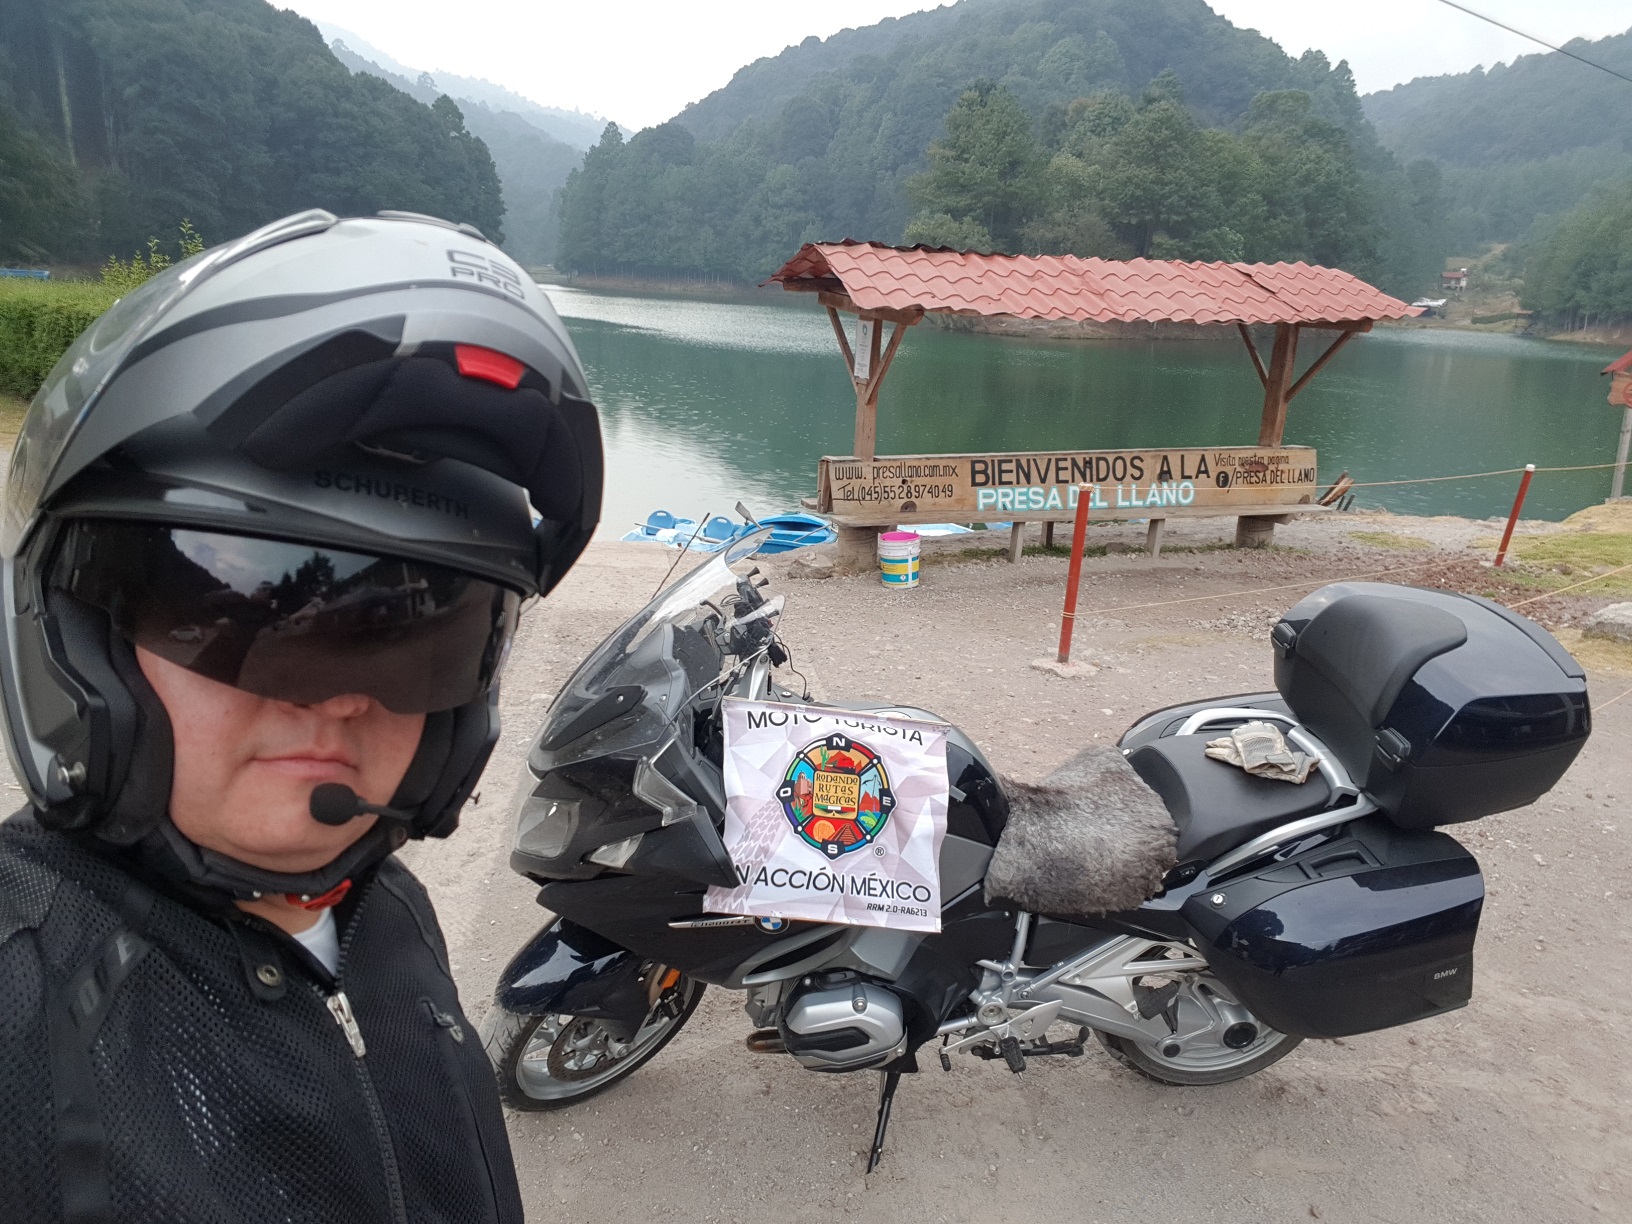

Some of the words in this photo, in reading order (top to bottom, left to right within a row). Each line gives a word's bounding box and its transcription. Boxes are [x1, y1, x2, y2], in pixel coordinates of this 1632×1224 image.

[446, 249, 521, 285] C3
[450, 266, 525, 300] PRO
[1214, 453, 1236, 467] Visita
[1238, 452, 1265, 466] nuestra
[970, 455, 1145, 487] BIENVENIDOS
[1157, 454, 1174, 482] A
[1180, 454, 1210, 480] LA
[1270, 469, 1286, 485] DEL
[1287, 467, 1315, 484] LLANO
[314, 470, 469, 519] SCHUBERTH
[977, 486, 1063, 511] PRESA
[1117, 481, 1196, 508] LLANO
[832, 737, 846, 747] N
[882, 796, 892, 806] E
[827, 844, 838, 854] S
[736, 864, 750, 884] N
[753, 866, 845, 894] ACCIÓN
[850, 872, 931, 903] MÉXICO
[866, 903, 885, 912] RRM
[1434, 967, 1458, 980] BMW
